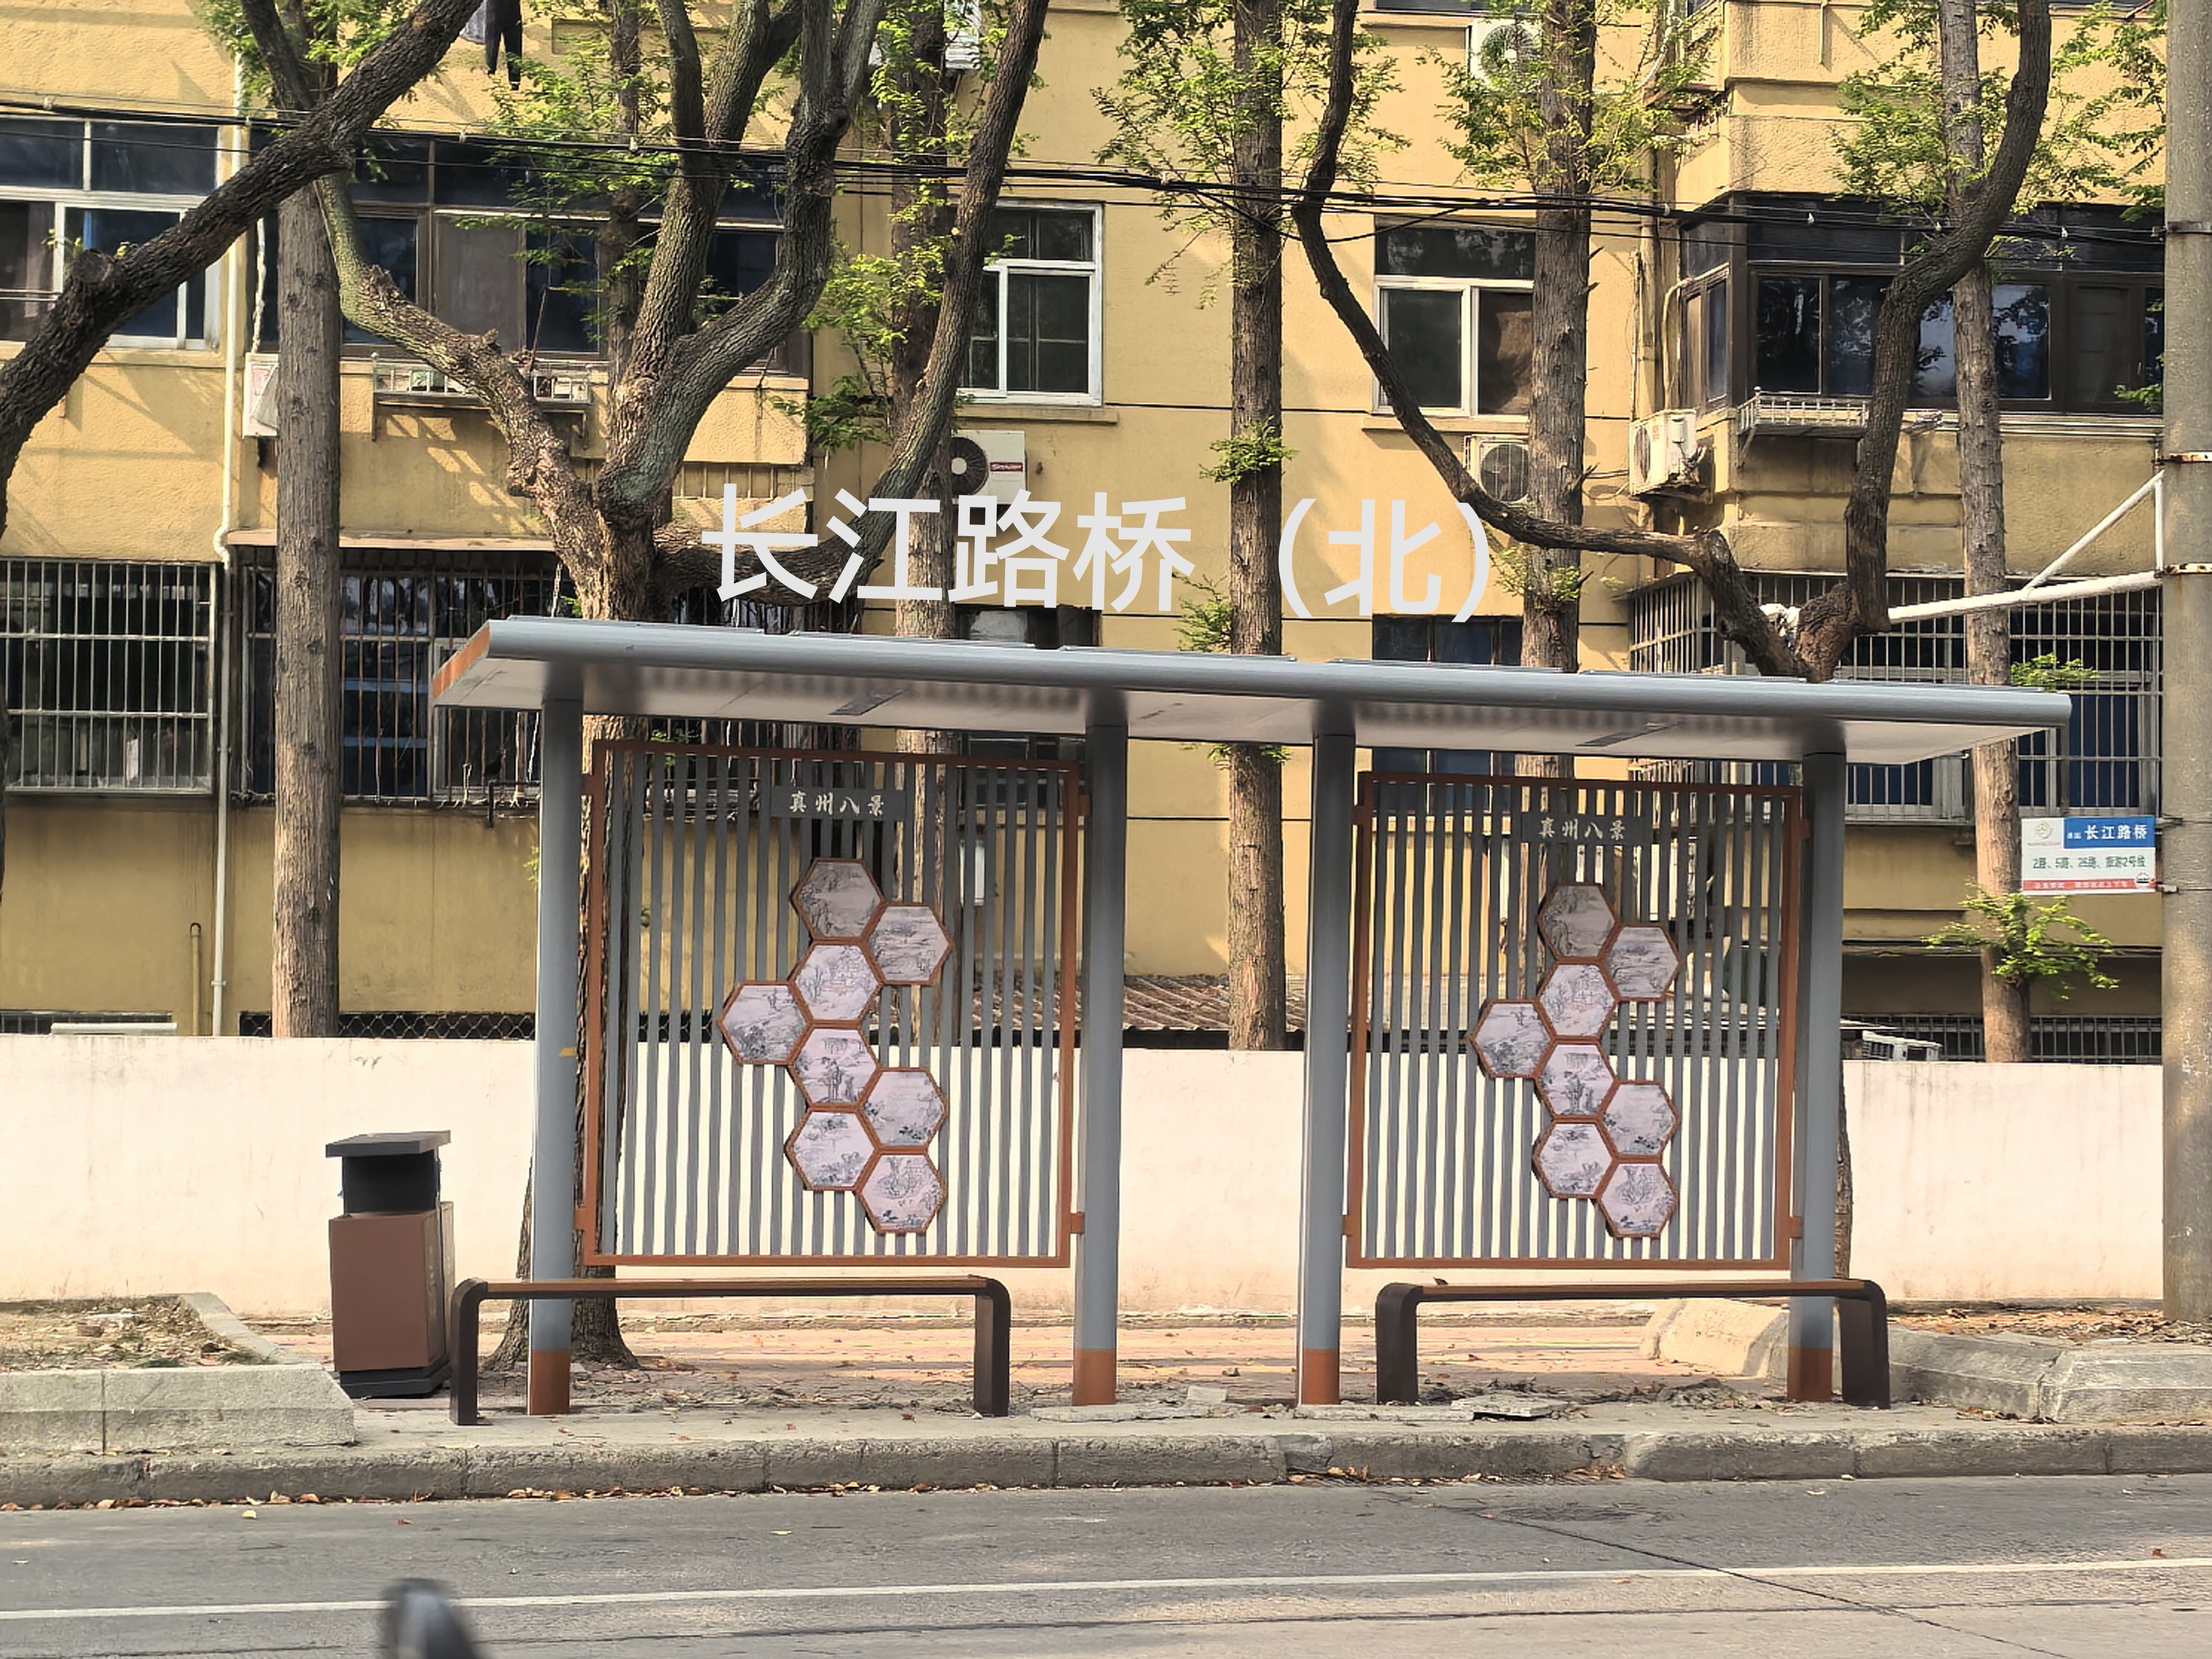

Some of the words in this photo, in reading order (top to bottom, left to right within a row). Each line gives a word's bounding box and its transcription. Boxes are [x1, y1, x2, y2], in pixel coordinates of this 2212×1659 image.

[790, 791, 884, 816] 真州八景
[1539, 817, 1625, 840] 真州八景
[2085, 825, 2148, 840] 长江路桥
